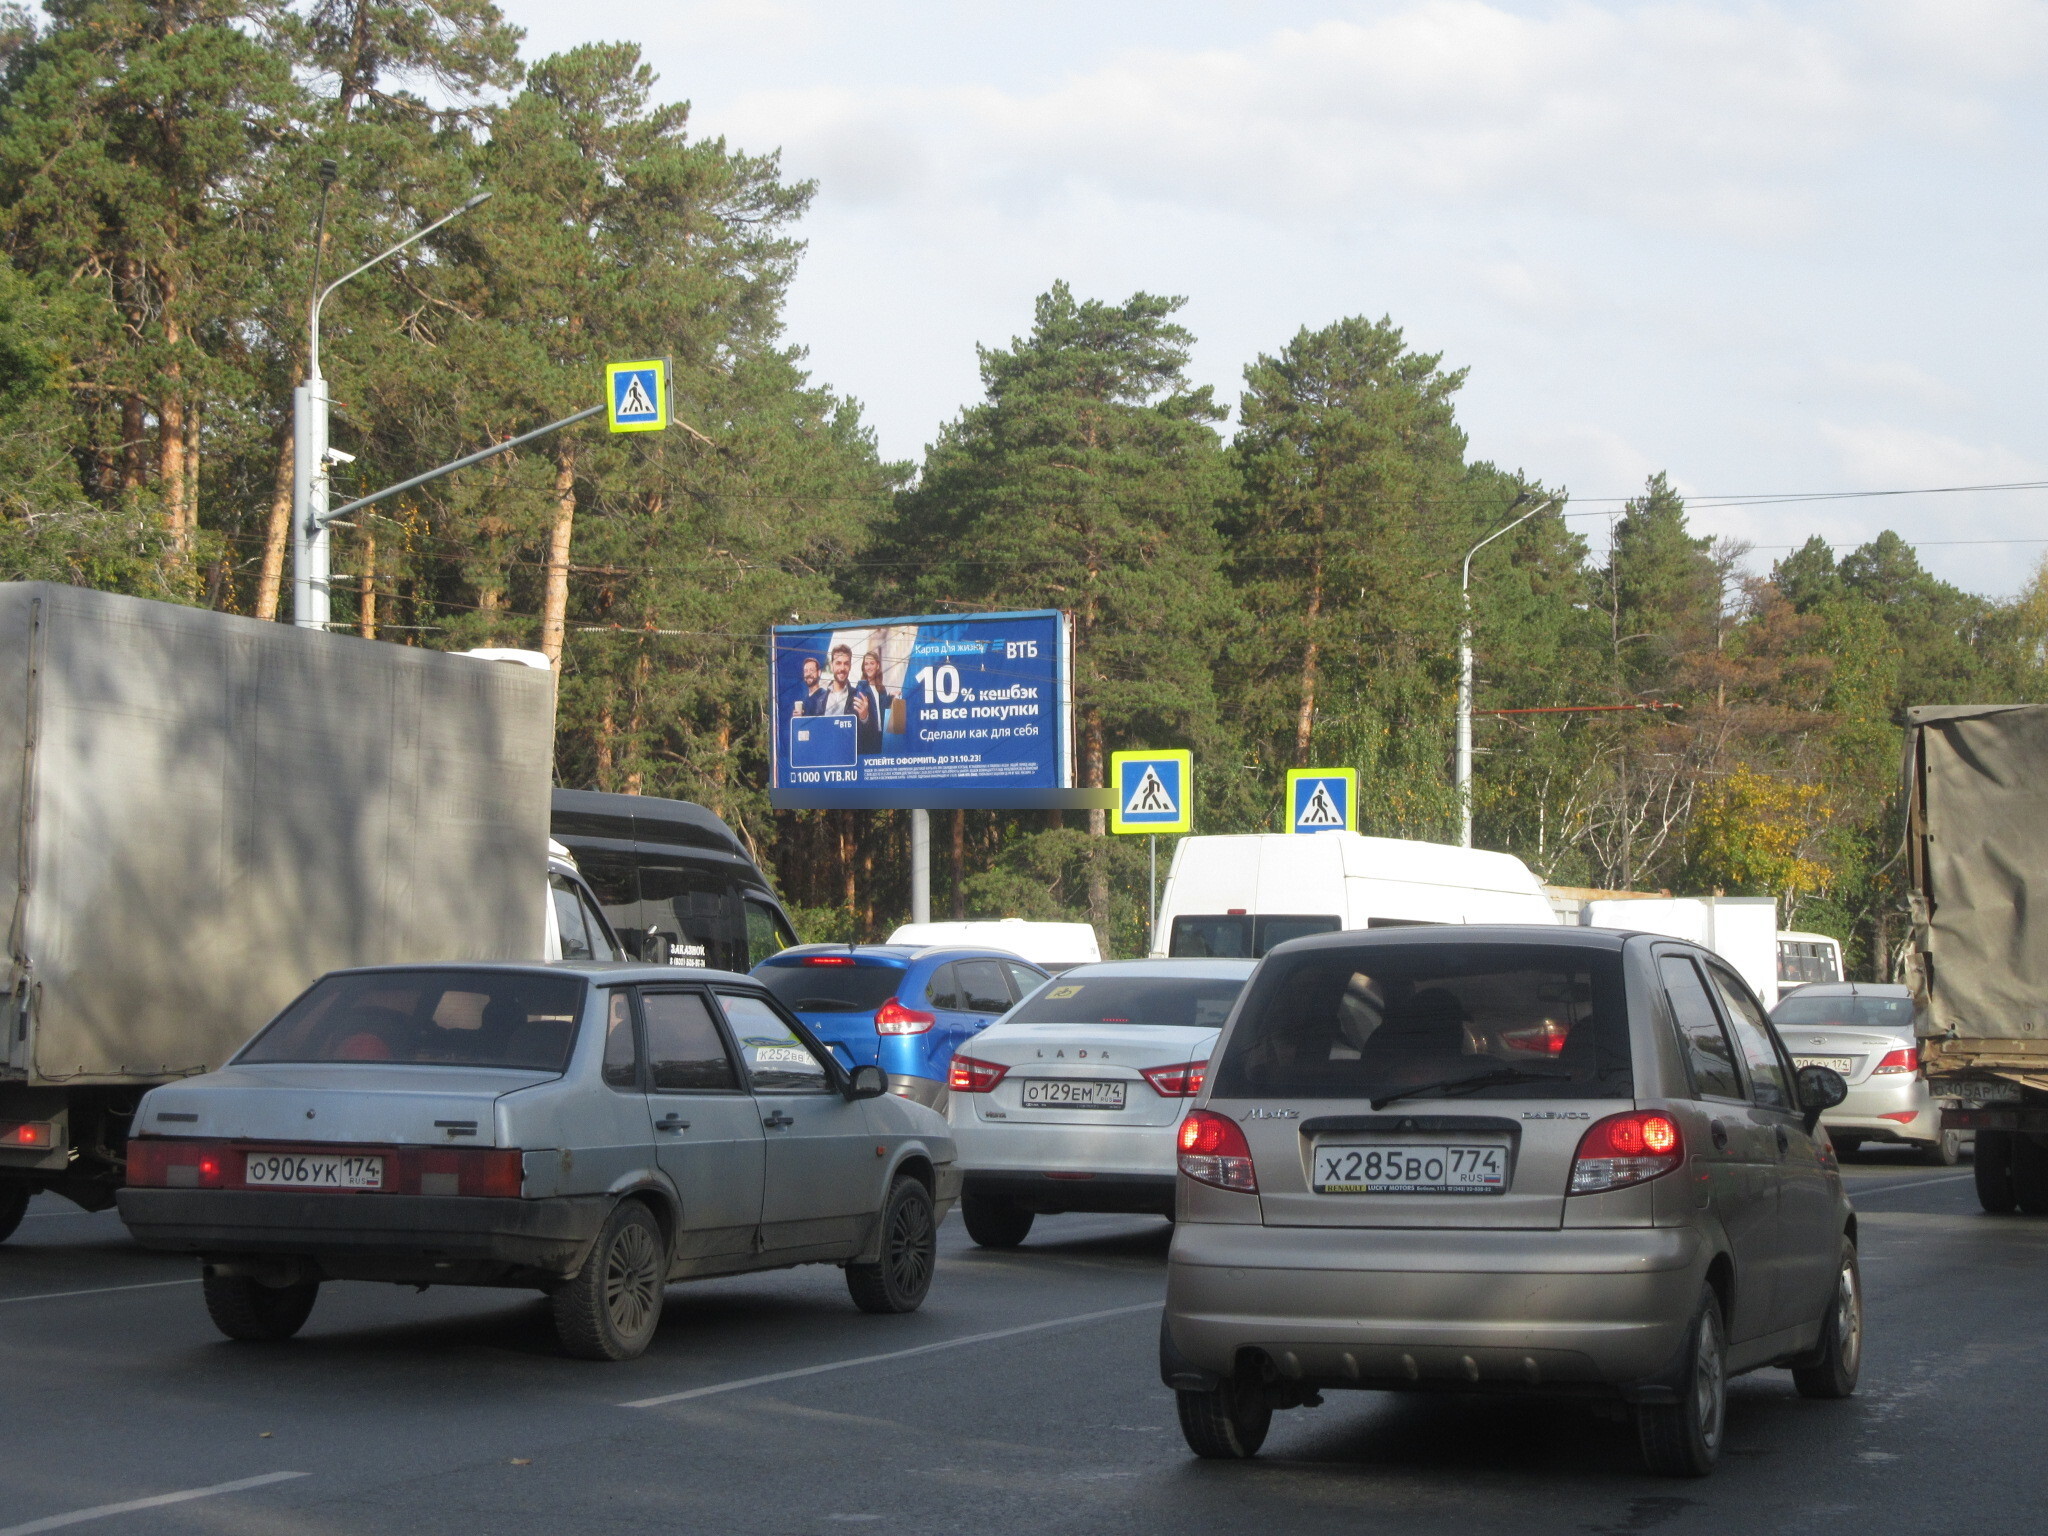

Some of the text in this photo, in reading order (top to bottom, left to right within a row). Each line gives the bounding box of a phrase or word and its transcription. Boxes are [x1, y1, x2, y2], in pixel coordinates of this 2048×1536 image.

[915, 644, 939, 655] Карта
[941, 643, 956, 654] для
[1007, 640, 1038, 659] ВТБ
[915, 664, 1038, 704] 10% кешбэк
[920, 704, 1039, 720] на все покупки
[839, 720, 852, 728] ВТБ
[920, 723, 1039, 741] Сделали как для себя
[864, 754, 982, 766] УСПЕЙТЕ ОФОРМИТЬ ДО 31.10.23!
[798, 772, 820, 782] 1000
[824, 771, 858, 781] VTB.RU
[1037, 1049, 1110, 1059] LADA
[1028, 1083, 1120, 1101] О129ЕМ 774
[1239, 1108, 1300, 1122] Matiz
[1521, 1111, 1591, 1120] DAEWOO
[253, 1157, 376, 1183] О906УК 174
[1325, 1149, 1497, 1182] Х285ВО 774
[349, 1177, 367, 1185] RUS
[1460, 1173, 1483, 1183] RUS
[1327, 1184, 1364, 1192] RENAULT
